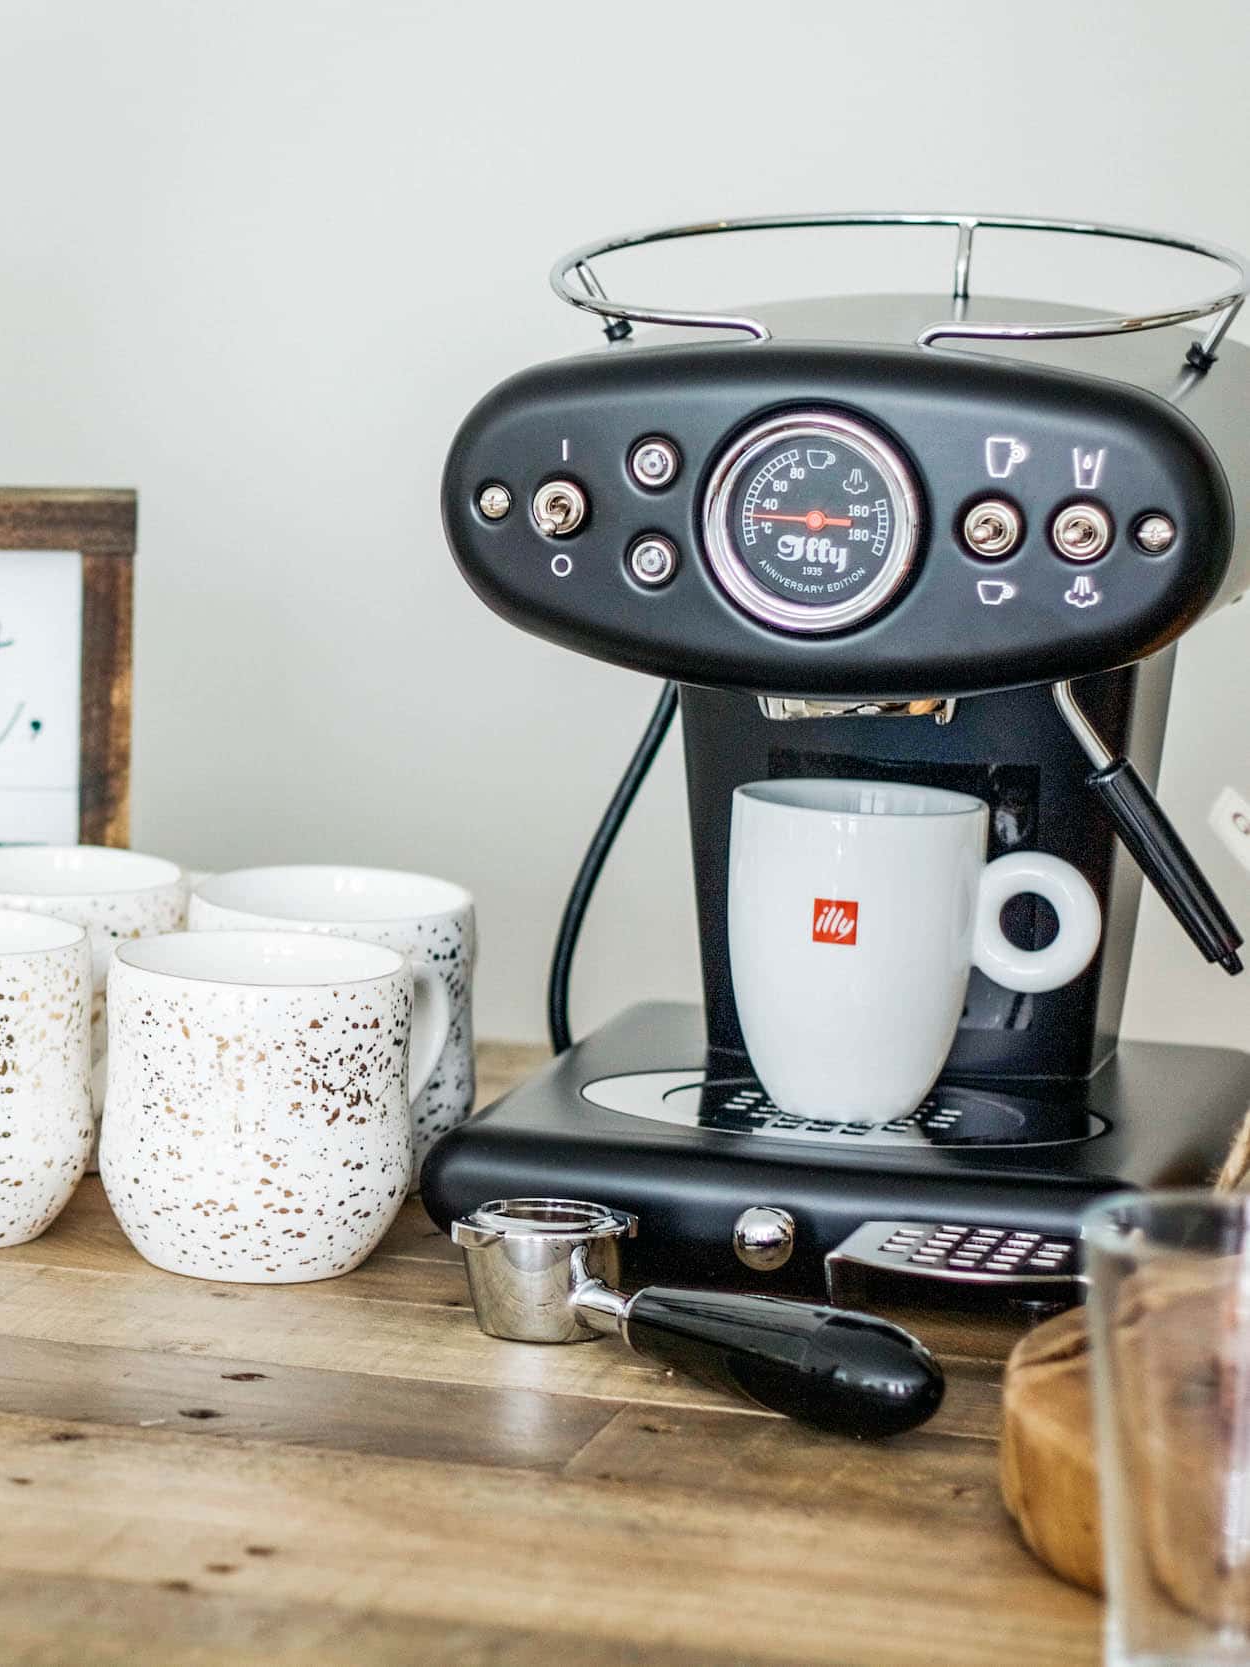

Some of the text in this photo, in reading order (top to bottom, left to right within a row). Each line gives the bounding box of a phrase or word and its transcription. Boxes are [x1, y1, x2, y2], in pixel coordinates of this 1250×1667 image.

[789, 467, 805, 480] 80
[772, 480, 788, 493] 60
[762, 498, 779, 511] 40
[848, 504, 870, 517] 160
[848, 527, 870, 542] 180
[758, 559, 866, 593] ANNIVERSARY EDITION
[802, 566, 823, 577] 1935
[815, 906, 855, 941] illy
